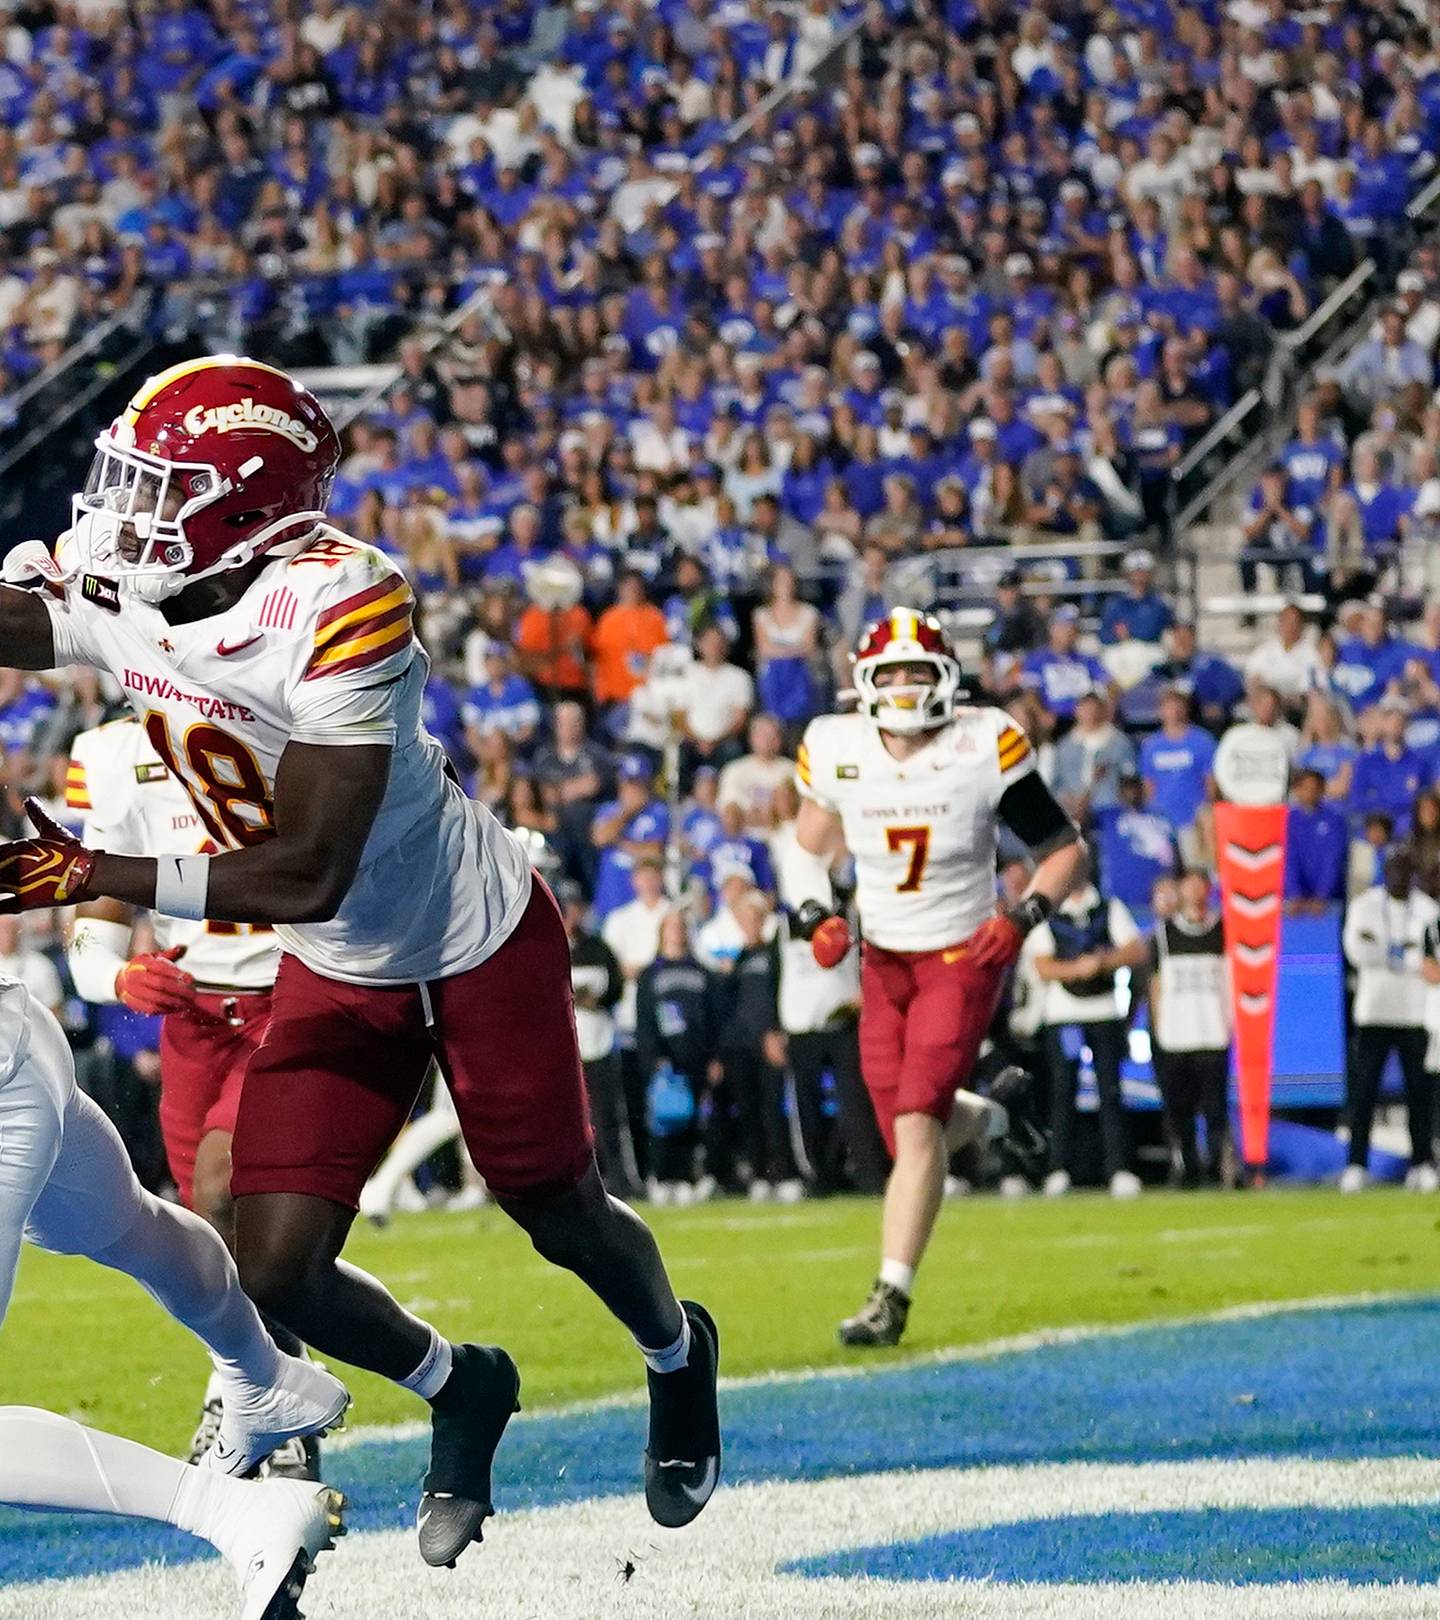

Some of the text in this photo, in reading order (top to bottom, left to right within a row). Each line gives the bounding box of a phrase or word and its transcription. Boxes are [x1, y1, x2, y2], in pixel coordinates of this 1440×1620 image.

[183, 397, 319, 453] Cyclones
[144, 708, 279, 850] 18
[885, 823, 932, 893] 7
